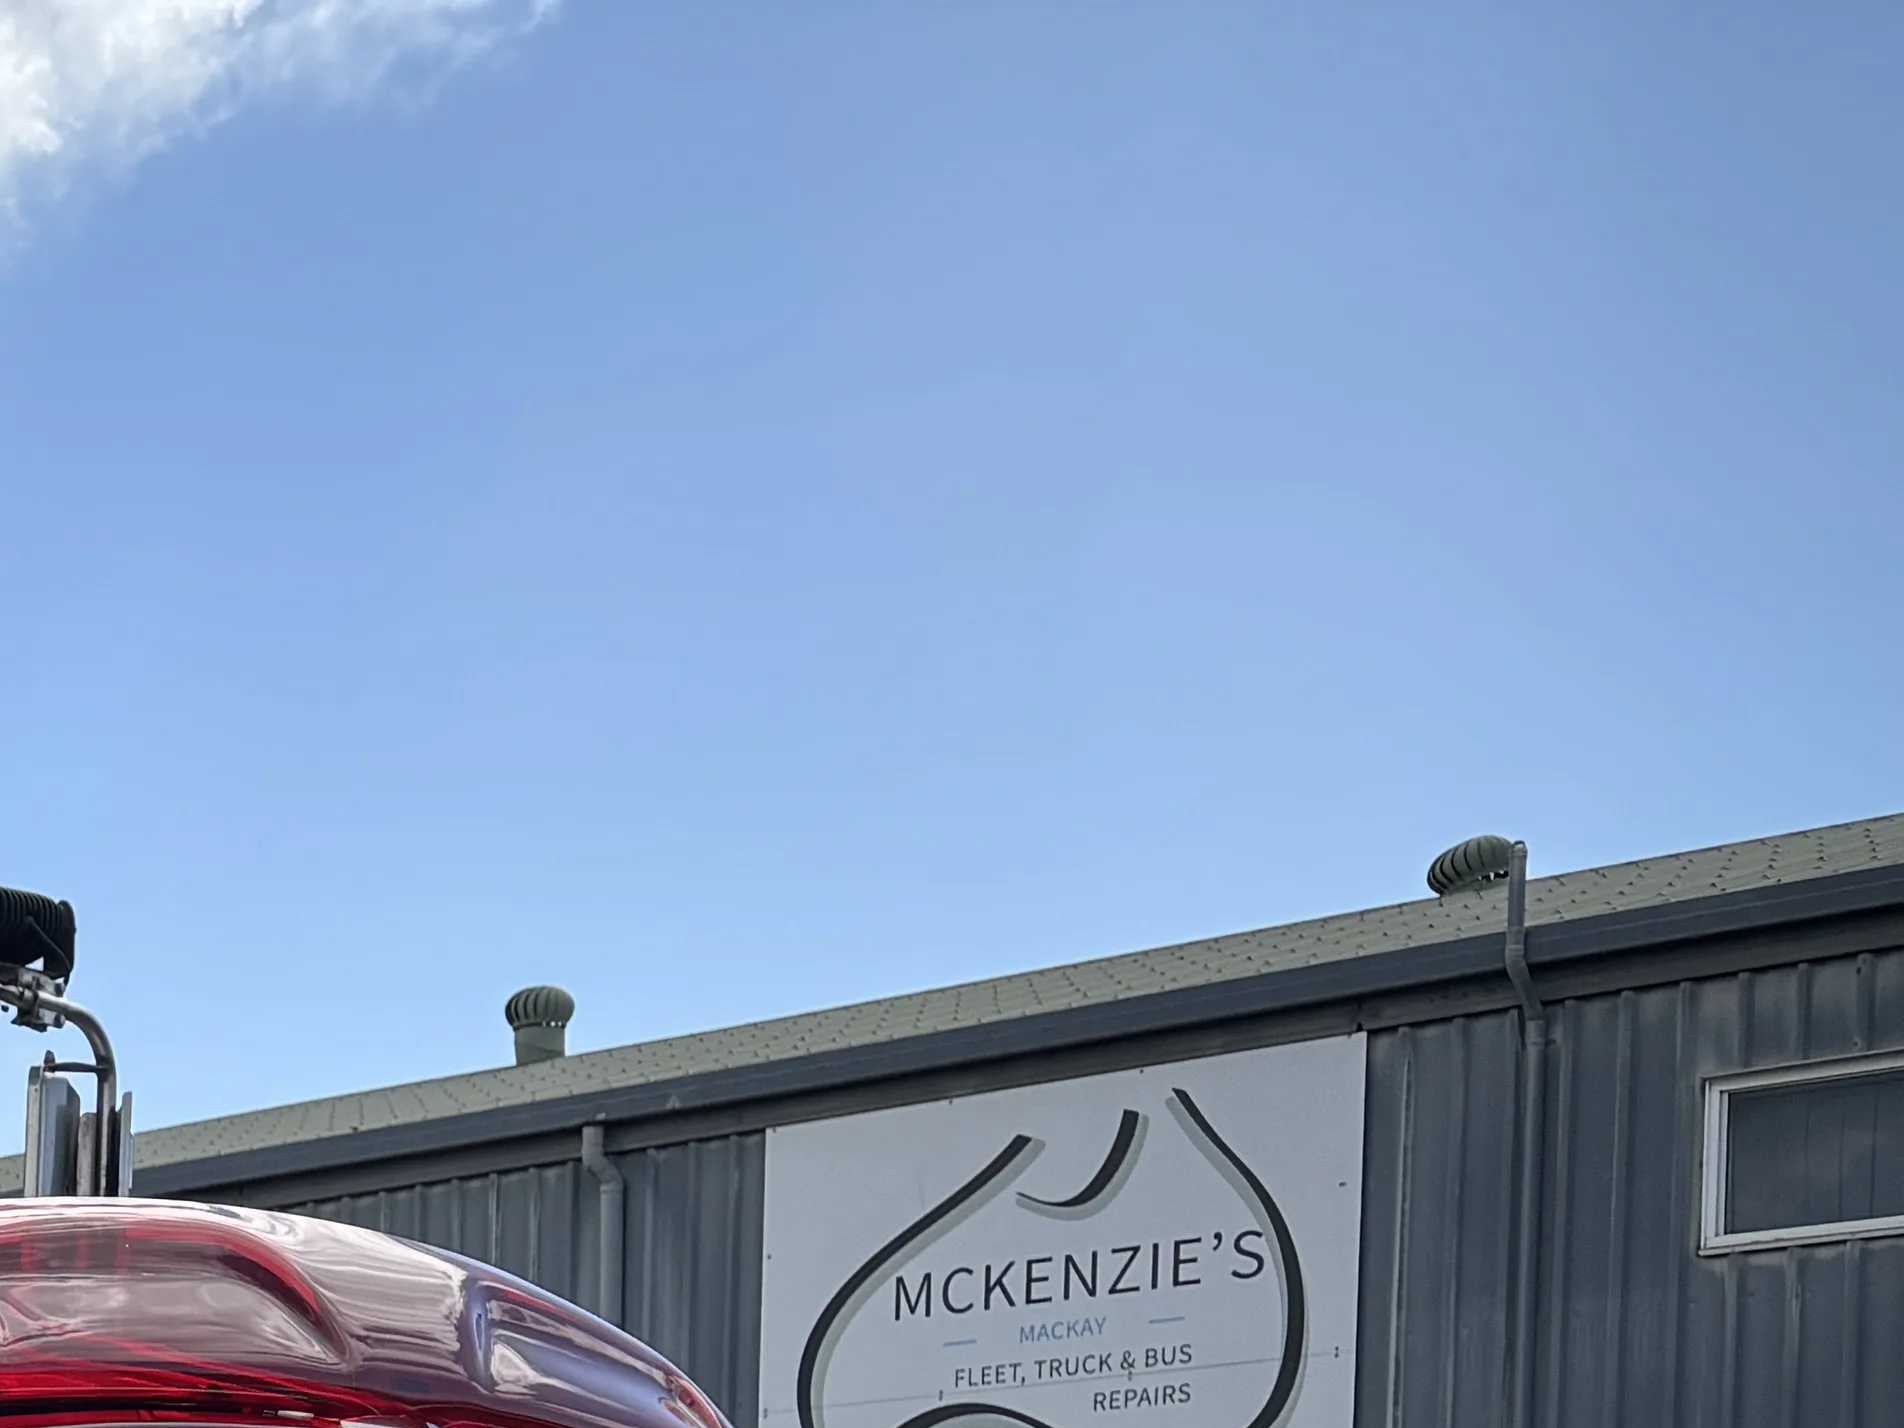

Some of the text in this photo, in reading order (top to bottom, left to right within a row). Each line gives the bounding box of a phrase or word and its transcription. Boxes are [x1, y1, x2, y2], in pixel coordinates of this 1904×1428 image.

[894, 1230, 1265, 1321] MCKENZIE'S
[1019, 1317, 1106, 1344] MACKAY
[954, 1344, 1193, 1388] FLEET, TRUCK & BUS
[1093, 1383, 1191, 1412] REPAIRS
